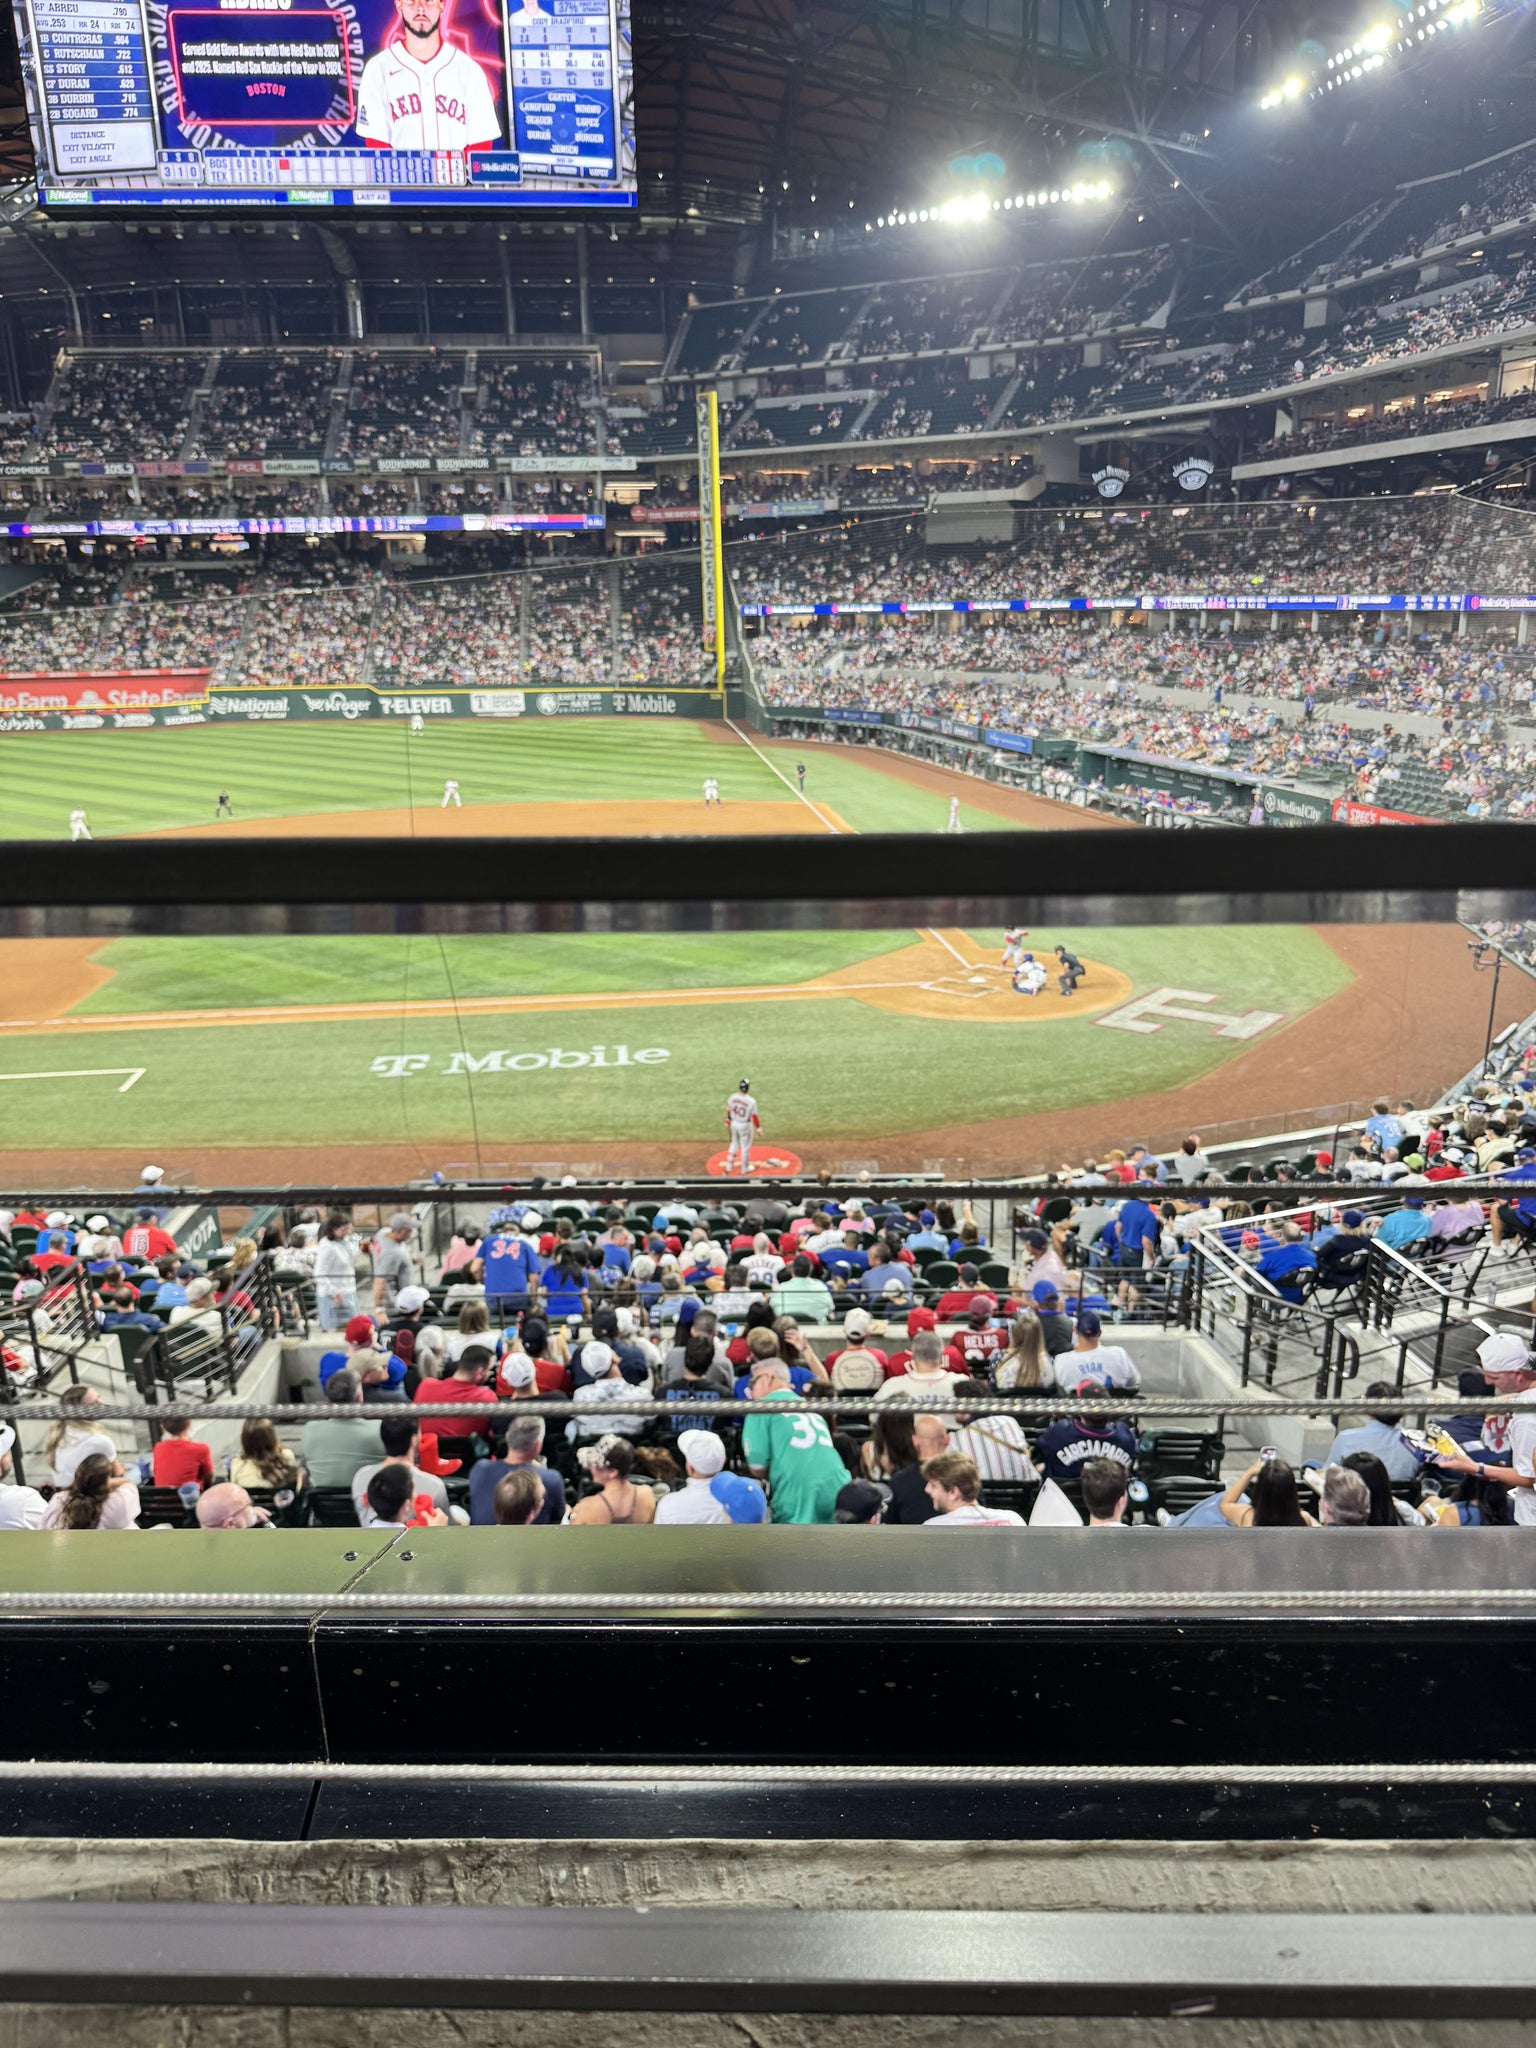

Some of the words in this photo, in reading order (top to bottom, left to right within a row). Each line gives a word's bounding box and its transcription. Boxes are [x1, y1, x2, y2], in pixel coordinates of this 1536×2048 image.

[34, 3, 45, 11] RF
[48, 3, 79, 13] ABREU
[91, 20, 100, 29] 24
[126, 21, 135, 30] 74
[52, 33, 103, 45] CONTRERAS
[54, 49, 105, 60] RUTSCHMAN
[182, 43, 205, 57] Earned
[206, 43, 220, 57] Gold
[221, 43, 239, 57] Glove
[240, 43, 264, 57] Awards
[264, 43, 279, 57] with
[279, 43, 291, 57] the
[292, 43, 303, 57] Red
[304, 43, 316, 57] Sox
[56, 63, 86, 74] STORY
[182, 61, 195, 75] and
[213, 61, 236, 75] Named
[236, 61, 249, 75] Red
[249, 61, 262, 75] Sox
[262, 61, 283, 75] Rookie
[291, 61, 302, 75] the
[302, 61, 318, 75] Year
[58, 78, 90, 89] DURAN
[246, 82, 286, 97] BOSTON
[60, 93, 95, 104] DURBIN
[62, 108, 98, 119] SOGARD
[71, 131, 105, 139] DISTANCE
[62, 144, 79, 152] EXIT
[81, 143, 115, 151] VELOCITY
[70, 156, 86, 164] EXIT
[89, 155, 113, 163] ANGLE
[209, 159, 228, 169] BOS
[164, 167, 171, 177] 3
[190, 167, 197, 177] 0
[211, 172, 227, 182] TEX
[57, 190, 88, 199] National
[298, 190, 328, 198] National
[104, 463, 134, 475] 105.3
[377, 458, 431, 471] BODYARMOR
[436, 457, 489, 470] BODYARMOR
[4, 465, 49, 476] COMMERCE
[17, 692, 68, 708] Farm
[108, 689, 157, 706] State
[628, 693, 676, 713] Mobile
[227, 696, 290, 713] National
[324, 691, 372, 720] Kroger
[164, 713, 207, 726] HONDA
[1350, 807, 1378, 825] SPEC'S
[441, 1044, 672, 1075] Mobile
[180, 1214, 218, 1260] YOTA
[490, 1239, 521, 1260] 34
[963, 1334, 999, 1349] HELMS
[1078, 1361, 1103, 1375] RYAN
[789, 1412, 833, 1449] 35
